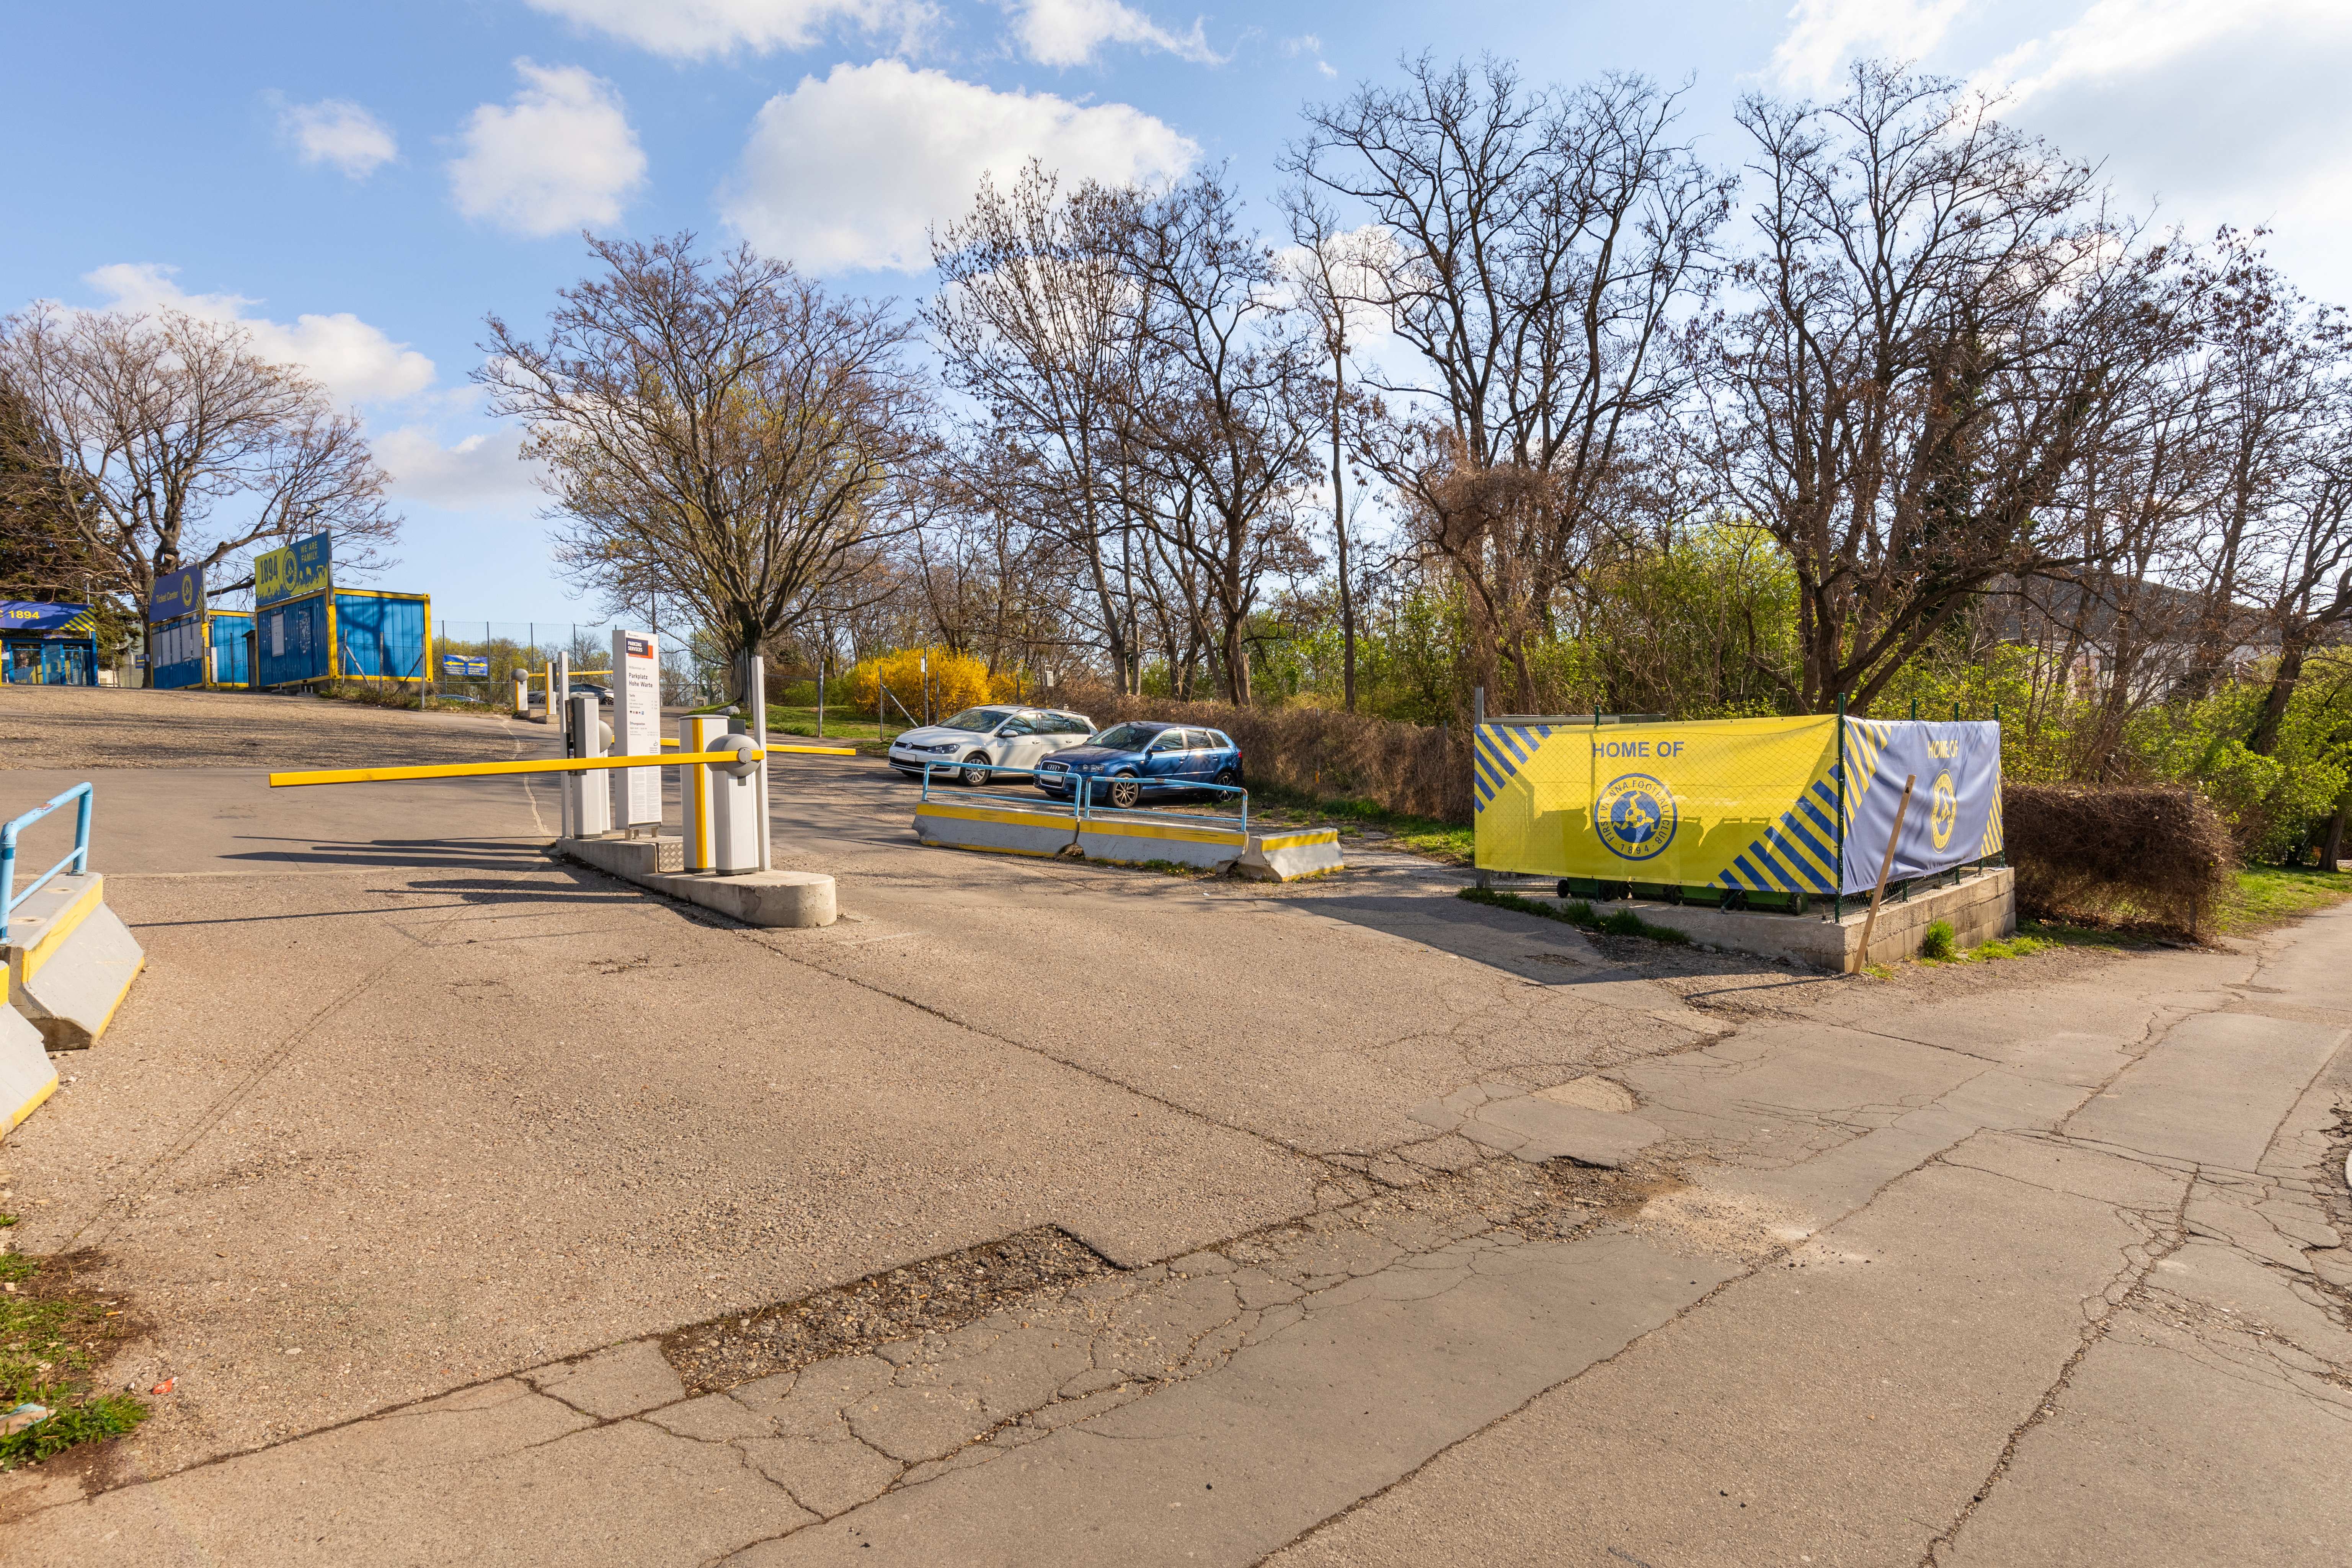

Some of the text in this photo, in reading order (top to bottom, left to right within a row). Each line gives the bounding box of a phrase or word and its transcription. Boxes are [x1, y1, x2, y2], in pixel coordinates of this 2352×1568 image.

[300, 541, 317, 553] WE ARE
[301, 551, 319, 563] FAMILY.
[260, 555, 278, 584] 1894
[156, 591, 178, 604] Ticket Center
[8, 610, 40, 619] 1894
[1592, 741, 1684, 758] HOME OF
[1928, 740, 1959, 759] HOME OF
[1600, 815, 1615, 842] FIRST
[1632, 780, 1670, 815] FOOTBALL
[1655, 819, 1670, 844] CLUB
[1620, 844, 1650, 855] 1894
